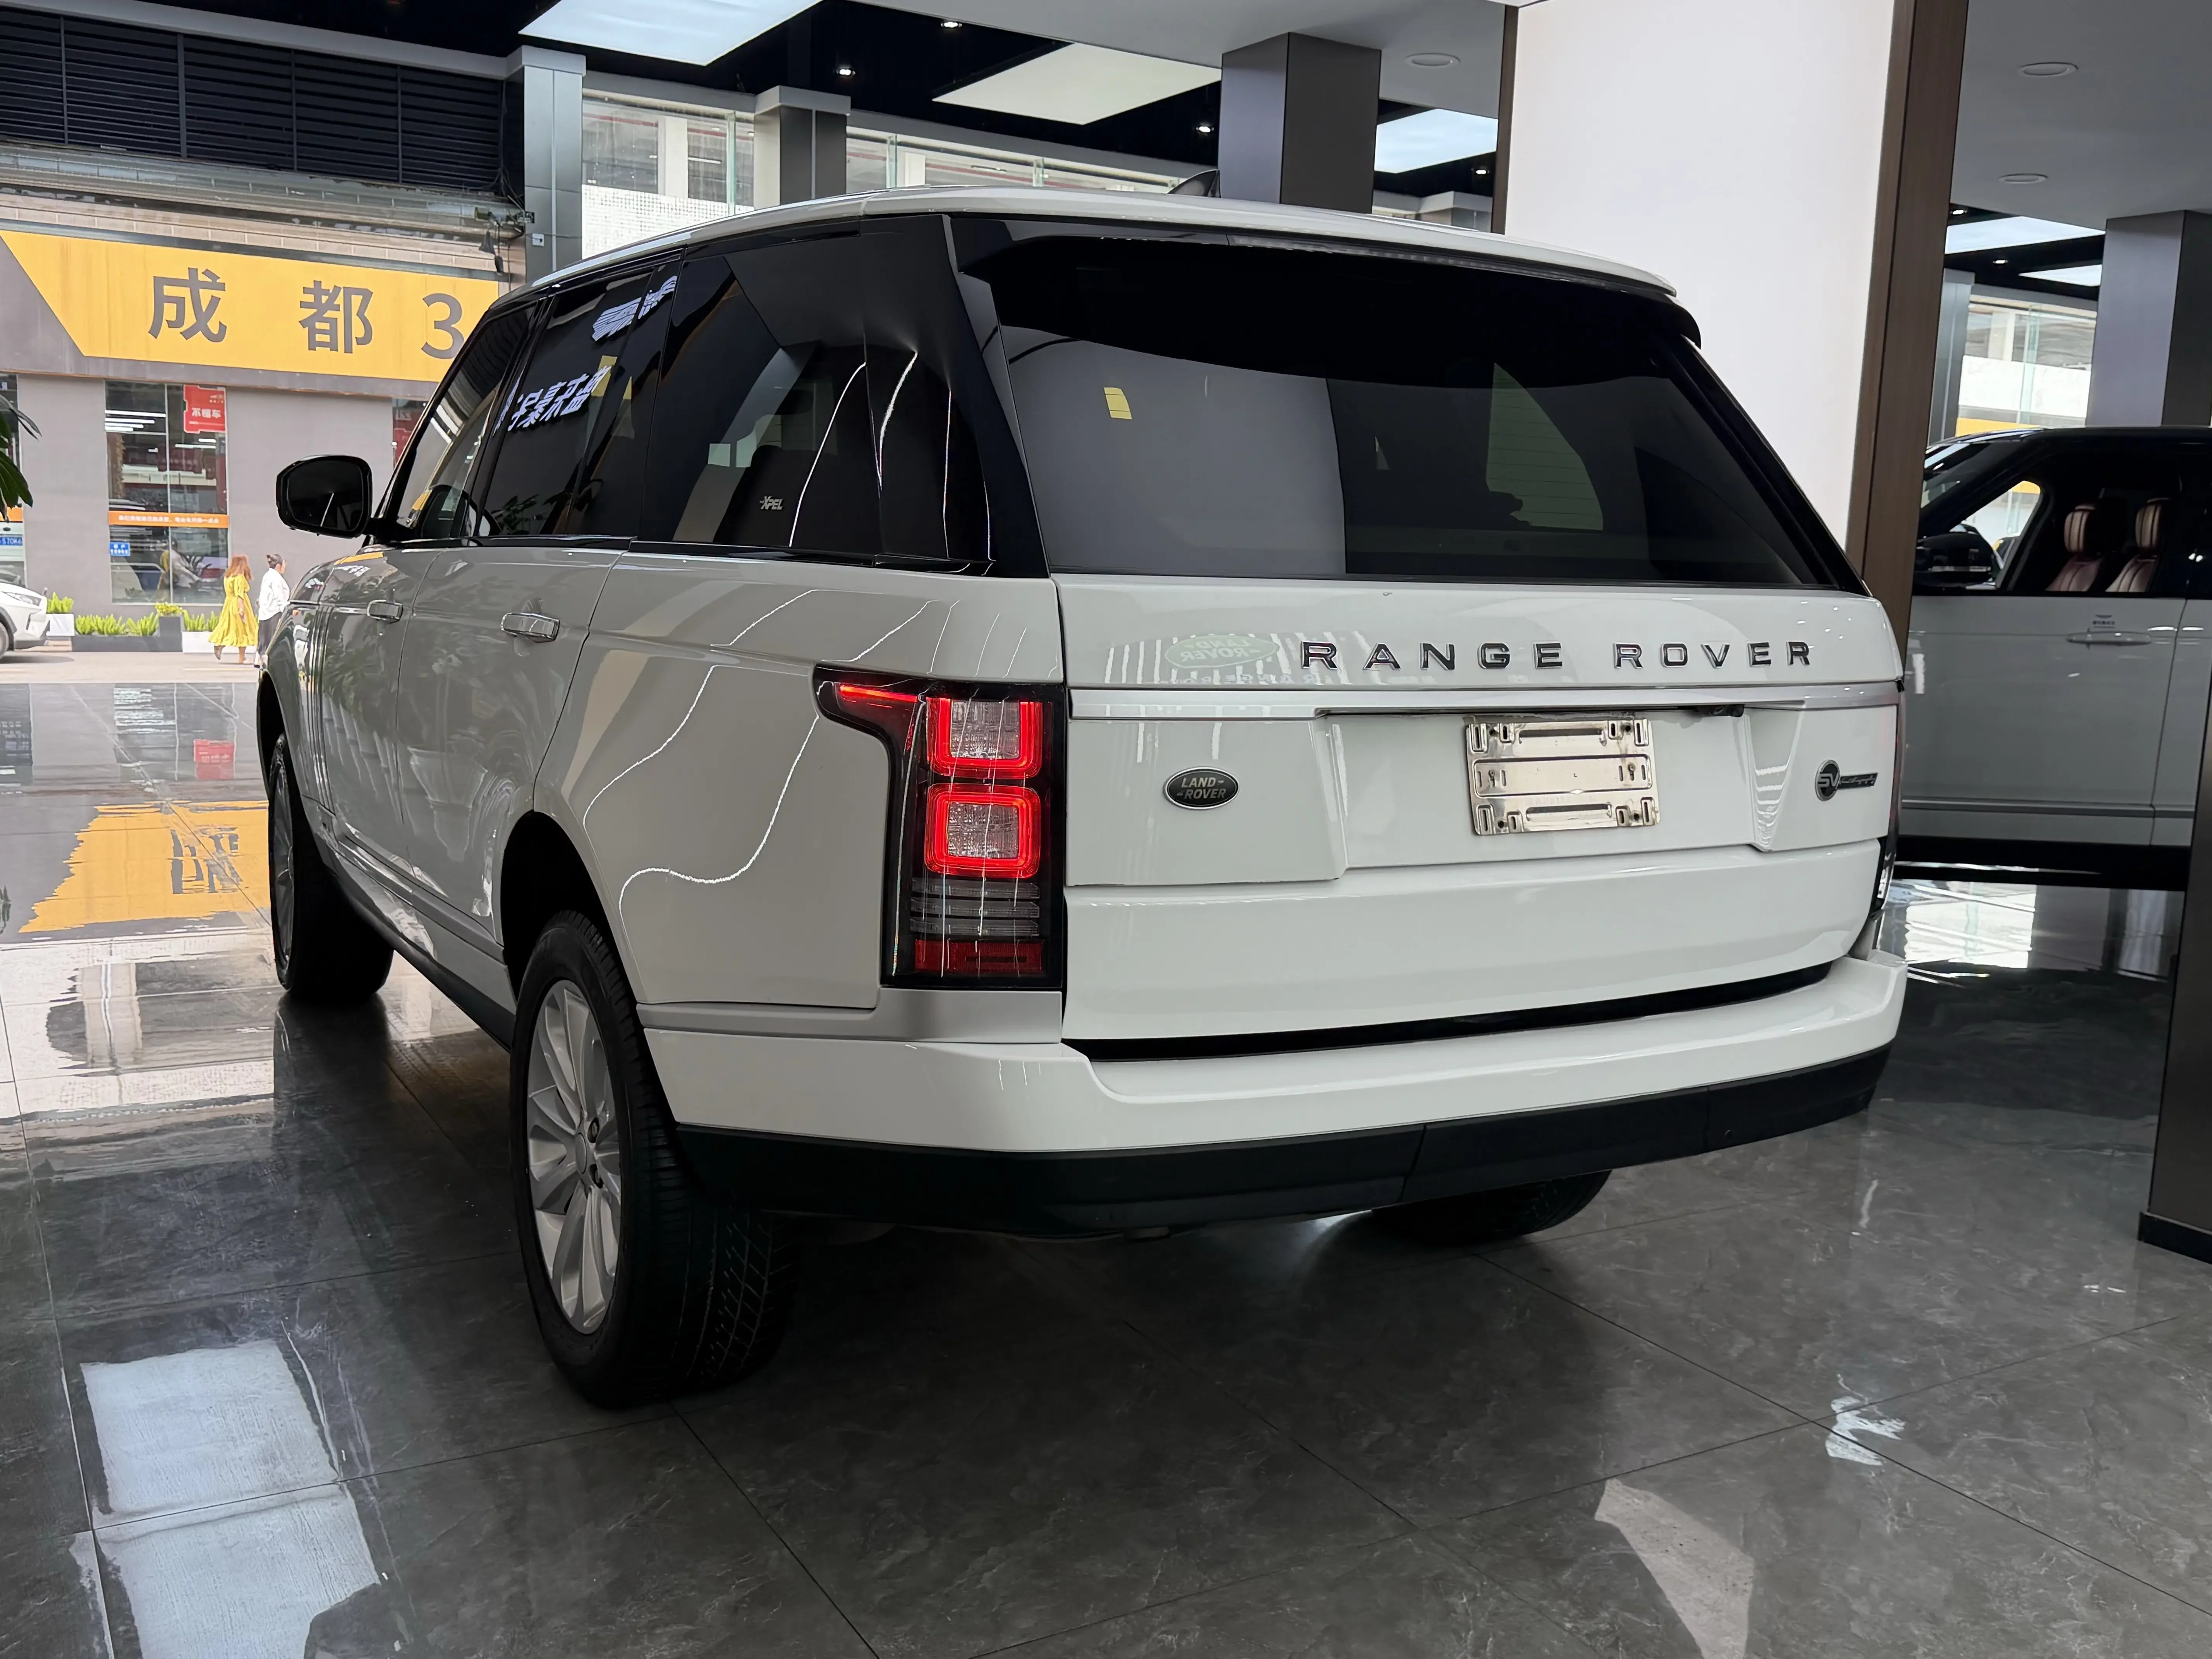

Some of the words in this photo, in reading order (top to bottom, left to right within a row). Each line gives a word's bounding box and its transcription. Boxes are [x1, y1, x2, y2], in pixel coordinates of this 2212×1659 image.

[760, 496, 784, 510] XPEL
[1300, 641, 1563, 671] RANGE
[1612, 641, 1811, 669] ROVER
[1181, 777, 1216, 788] LAND
[1817, 772, 1839, 787] SV
[1184, 788, 1225, 799] ROVER
